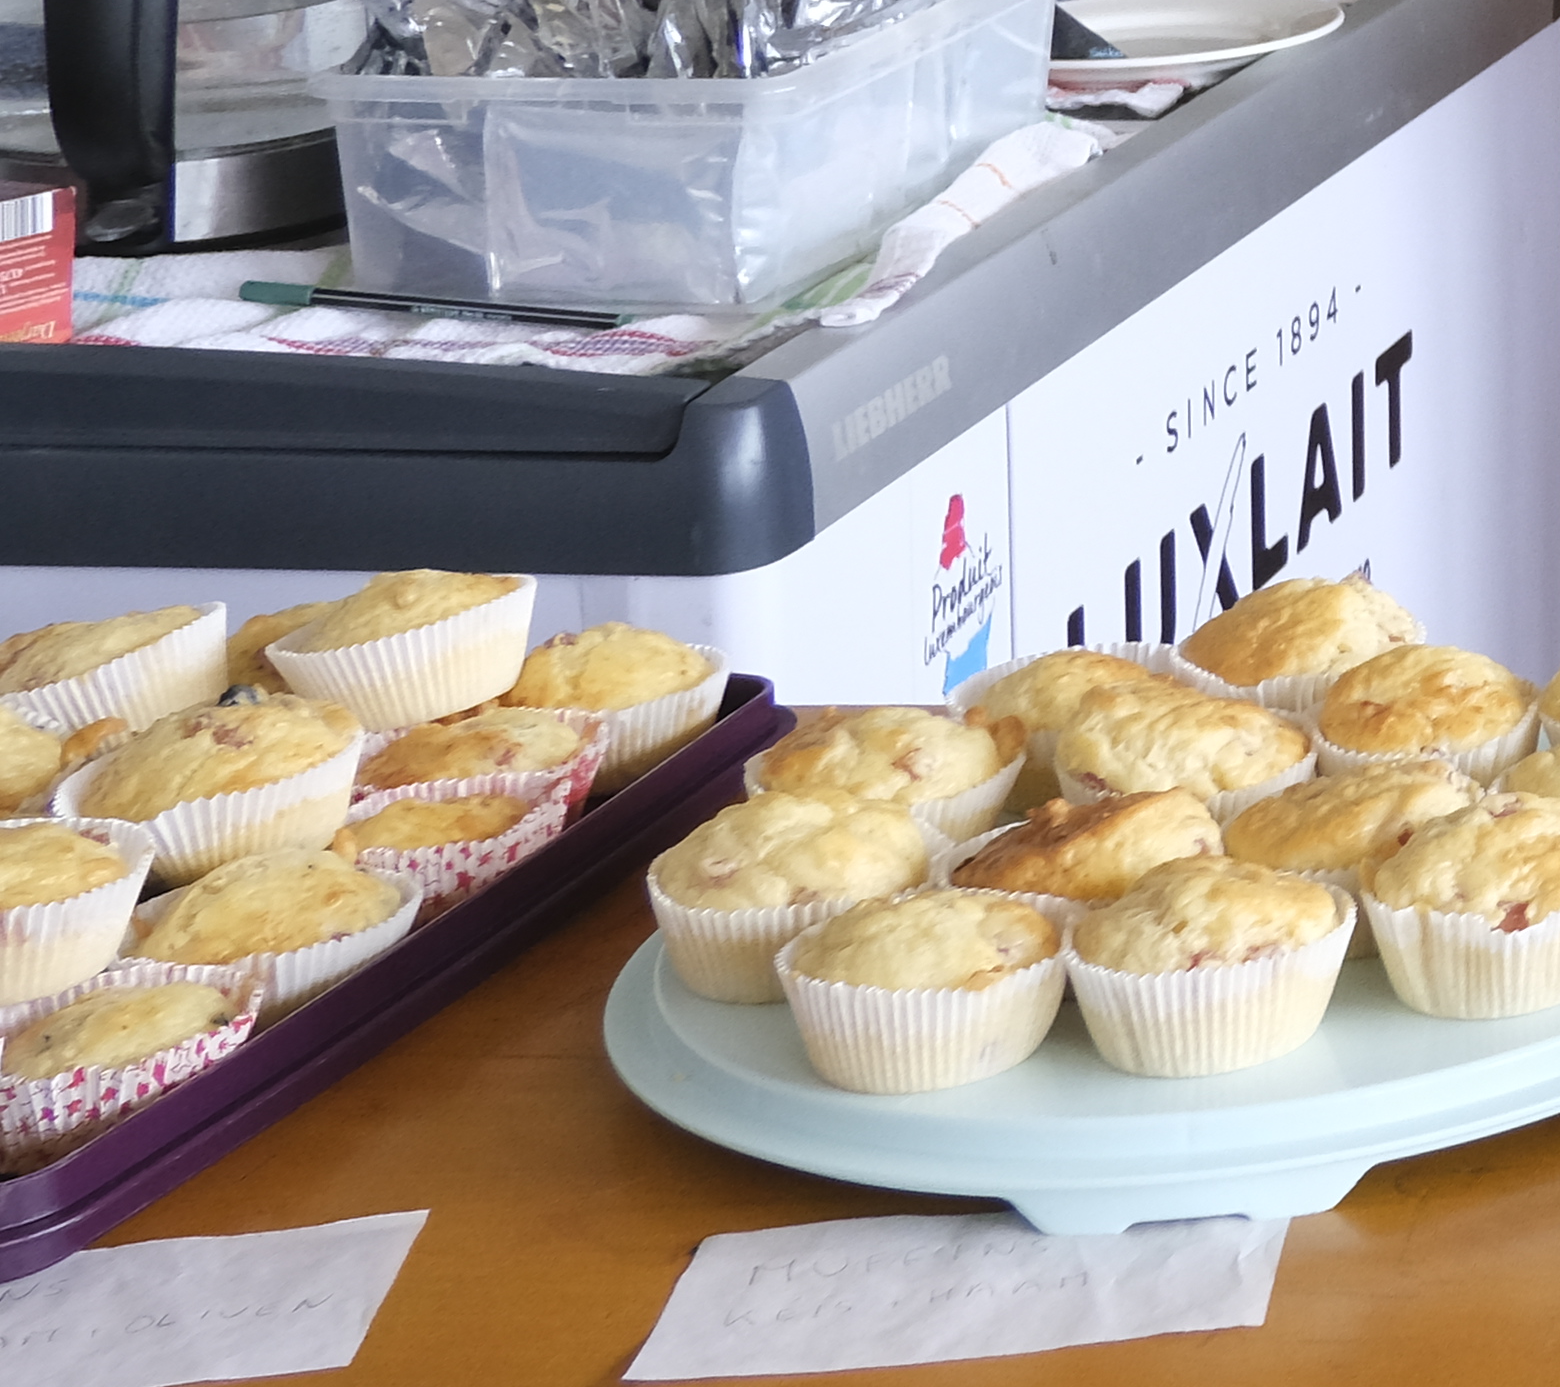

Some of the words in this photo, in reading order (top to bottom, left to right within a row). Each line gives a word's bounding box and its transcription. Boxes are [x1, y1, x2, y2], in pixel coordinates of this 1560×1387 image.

[831, 355, 952, 462] LIEBHERR
[1165, 348, 1257, 452] SINCE
[1275, 293, 1339, 367] 1894
[932, 533, 992, 633] Produit
